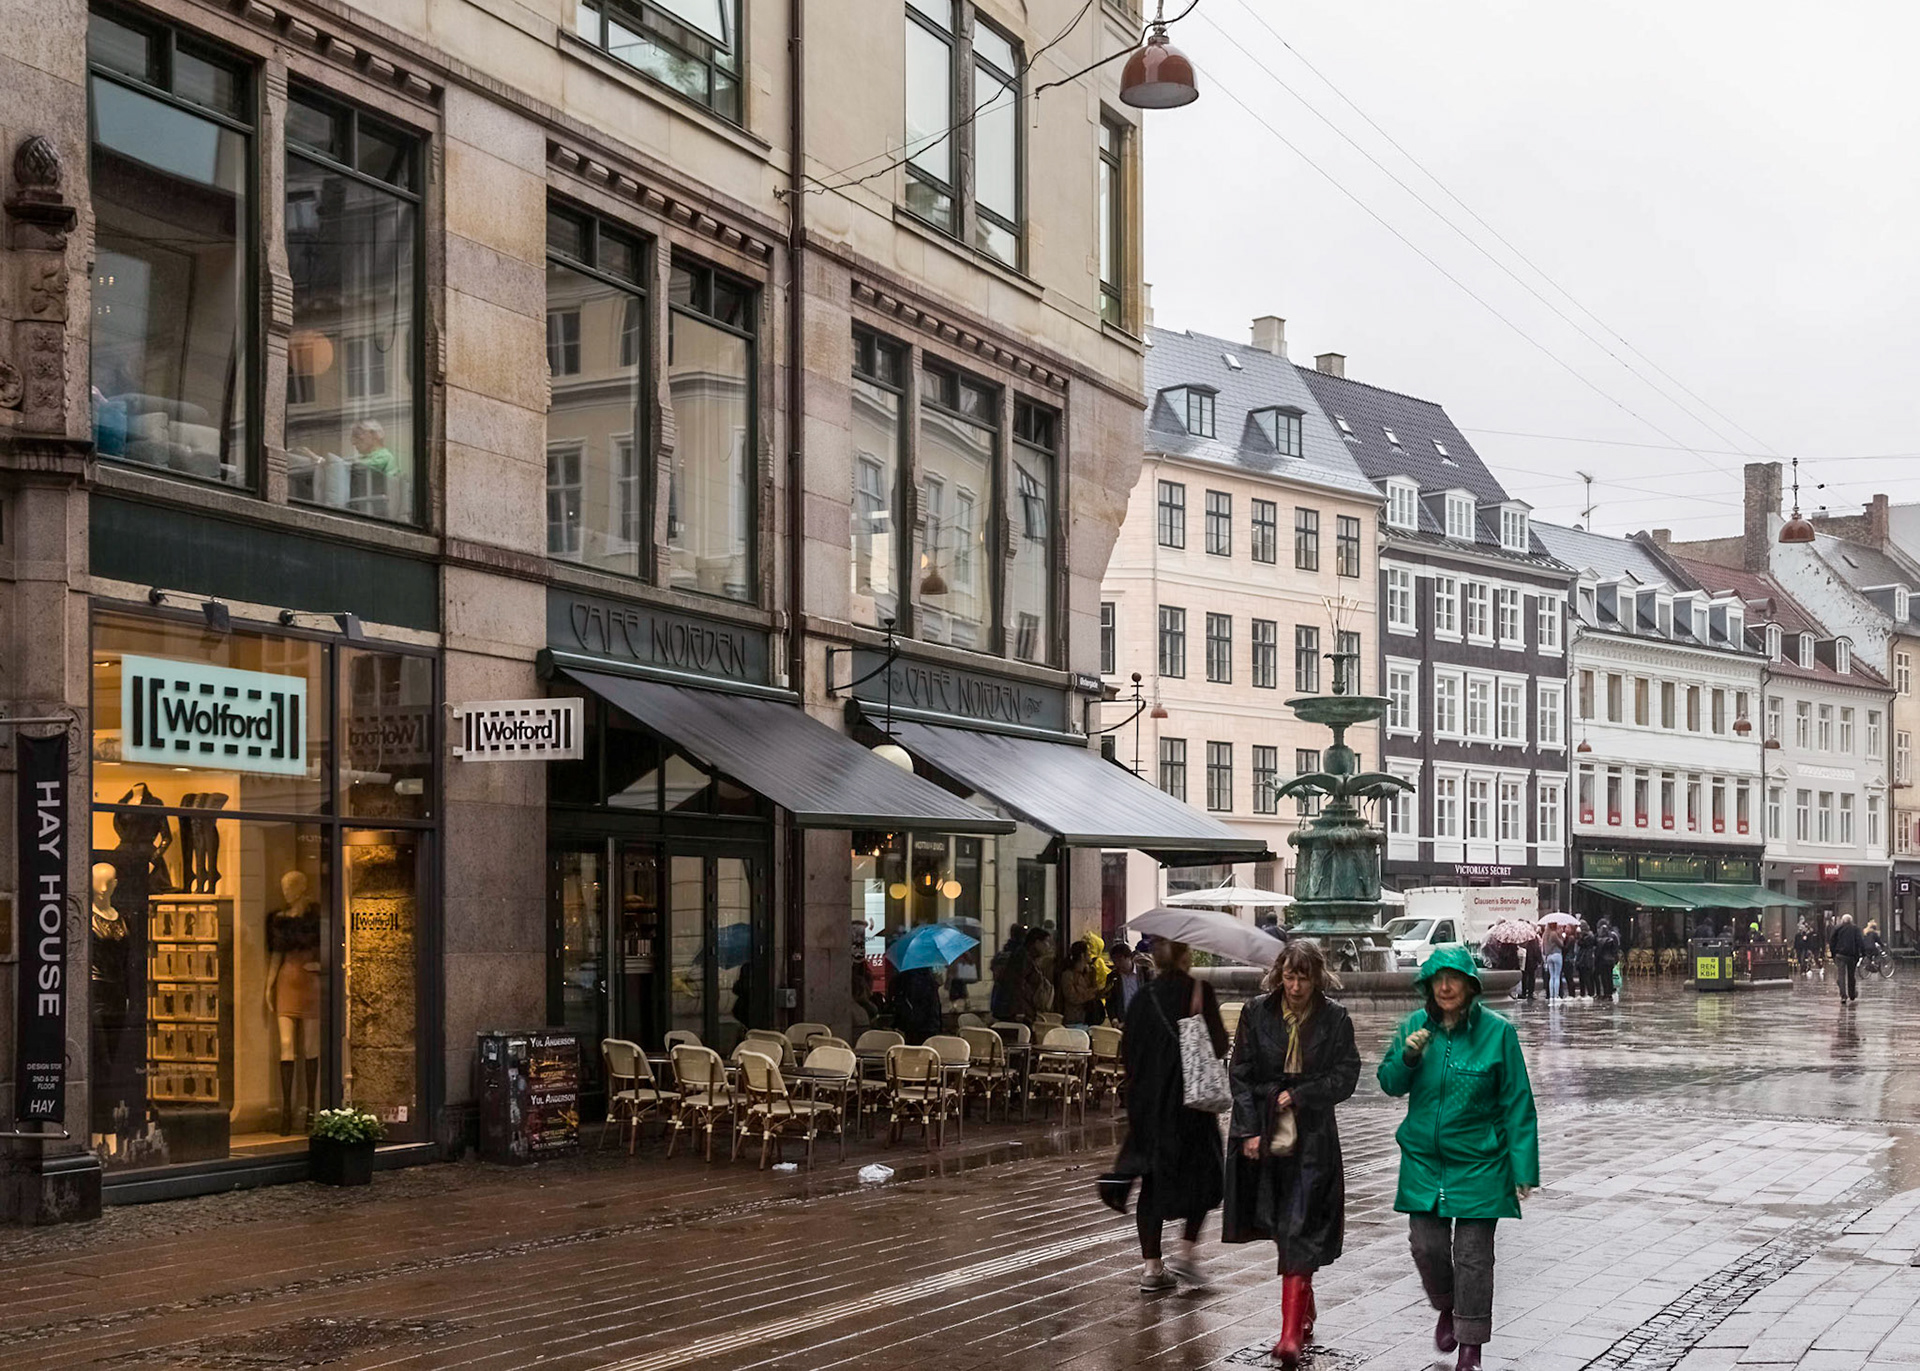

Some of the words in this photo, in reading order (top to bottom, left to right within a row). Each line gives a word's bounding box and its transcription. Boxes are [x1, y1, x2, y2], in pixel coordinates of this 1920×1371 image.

[651, 616, 746, 676] NORDEN
[163, 697, 273, 741] Wolford
[957, 675, 1022, 723] NORDEN
[483, 719, 553, 741] Wolford
[36, 780, 61, 860] HAY
[1454, 864, 1489, 876] VICTORIA'S
[1490, 866, 1512, 876] SECRET
[1474, 897, 1499, 905] Clausen's
[1500, 897, 1520, 905] Service
[38, 875, 61, 1018] HOUSE
[30, 1100, 55, 1113] HAY
